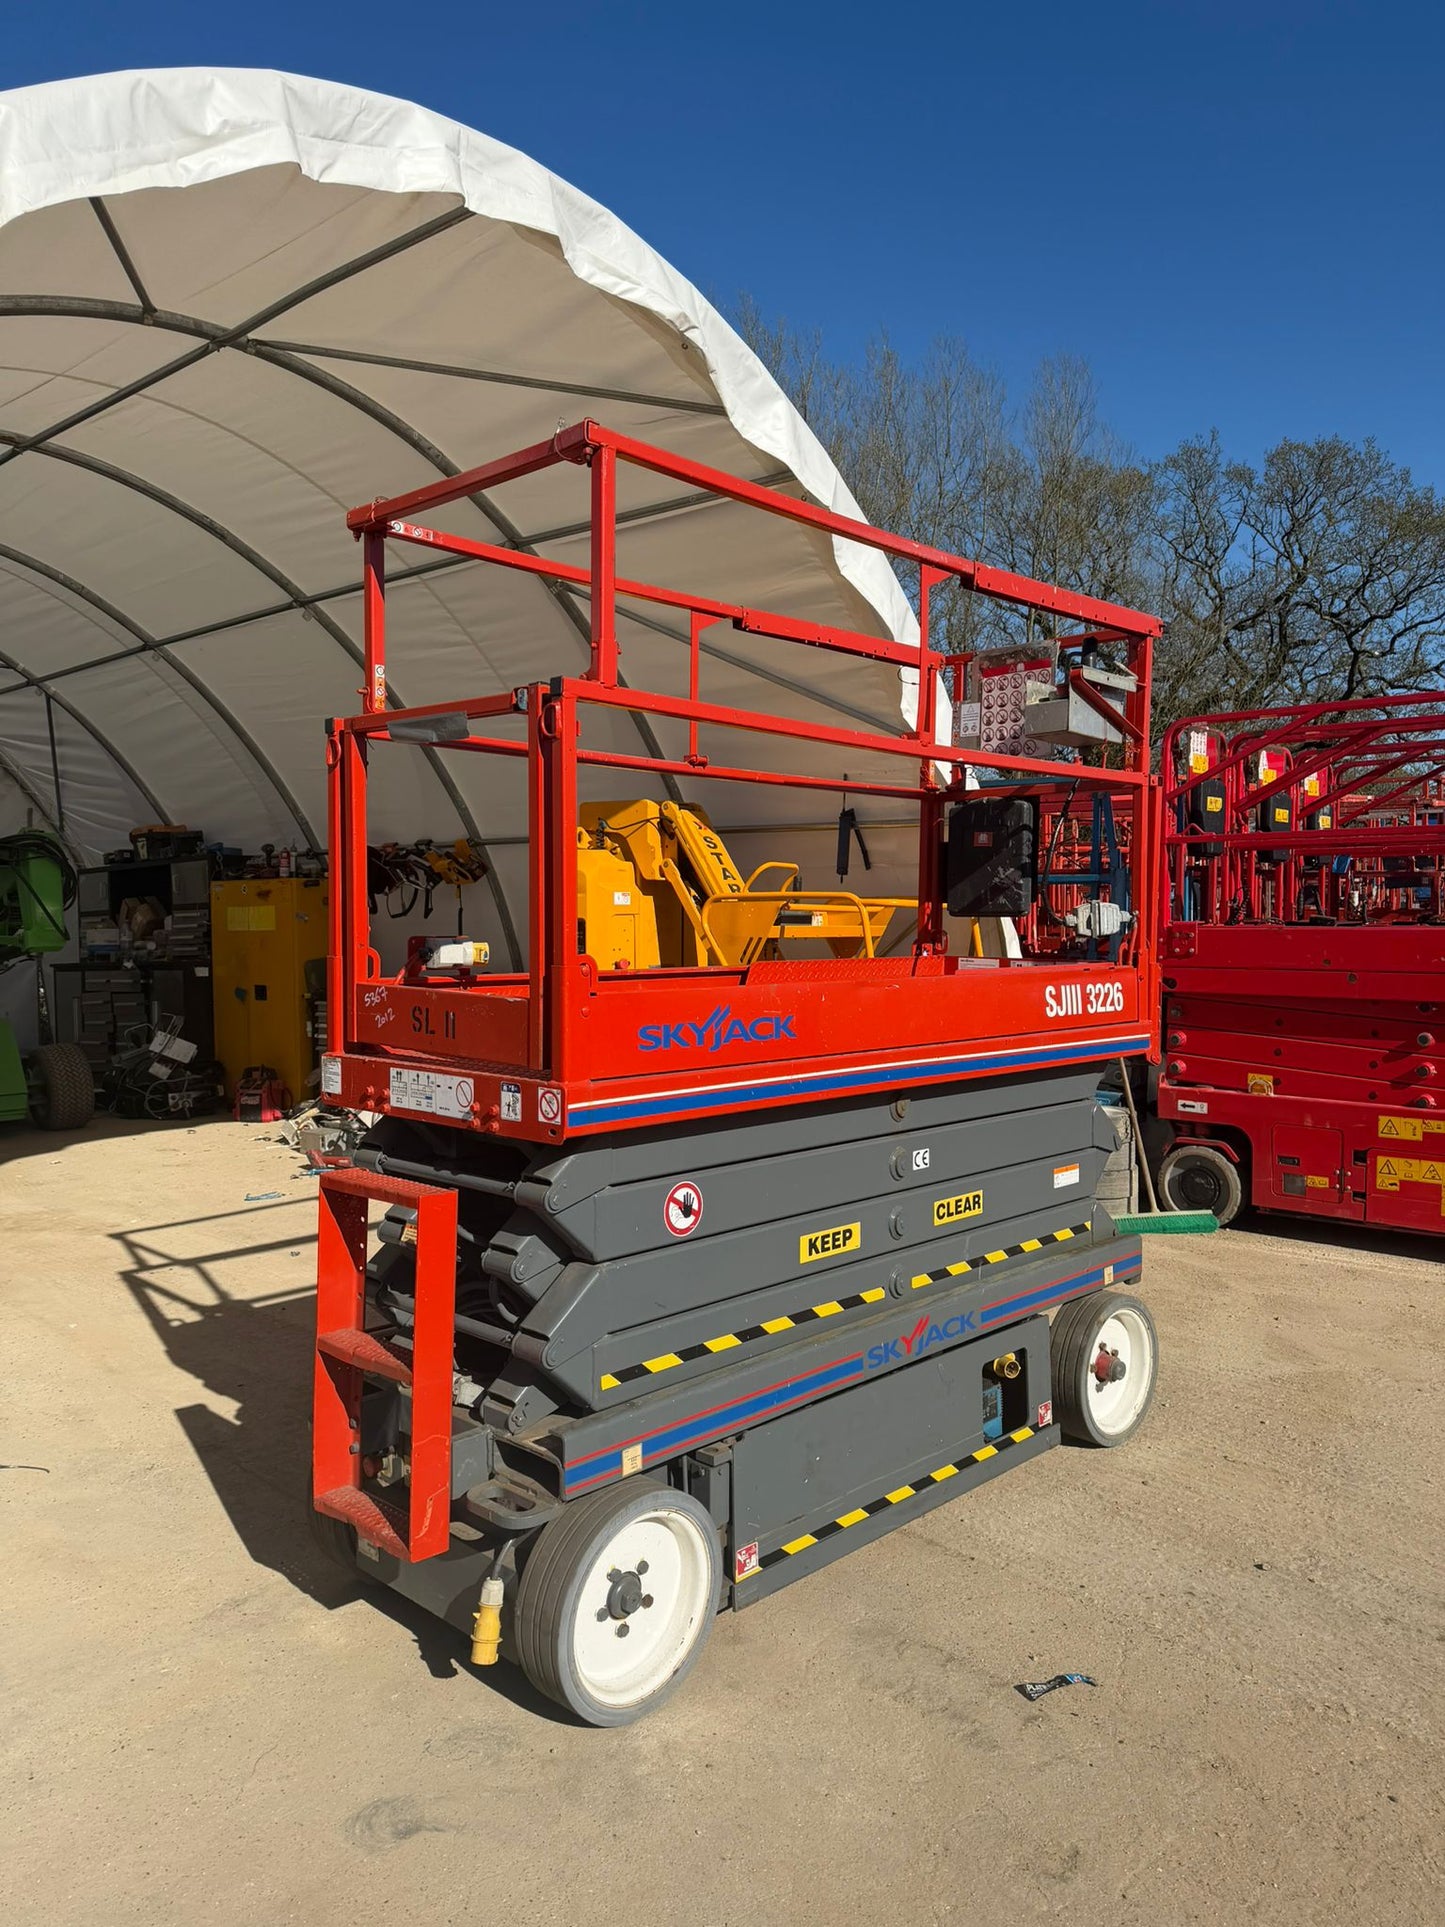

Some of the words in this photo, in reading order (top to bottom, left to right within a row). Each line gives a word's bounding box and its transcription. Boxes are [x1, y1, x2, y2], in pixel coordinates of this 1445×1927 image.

[364, 986, 388, 1007] 5367
[1045, 985, 1083, 1018] SJIII
[1086, 982, 1124, 1014] 3226
[375, 1008, 395, 1029] 2012
[411, 1005, 436, 1035] SL
[638, 1004, 797, 1052] SKYJACK
[914, 1150, 929, 1168] CE
[936, 1194, 981, 1221] CLEAR
[808, 1228, 853, 1257] KEEP
[867, 1310, 977, 1370] SKYJACK
